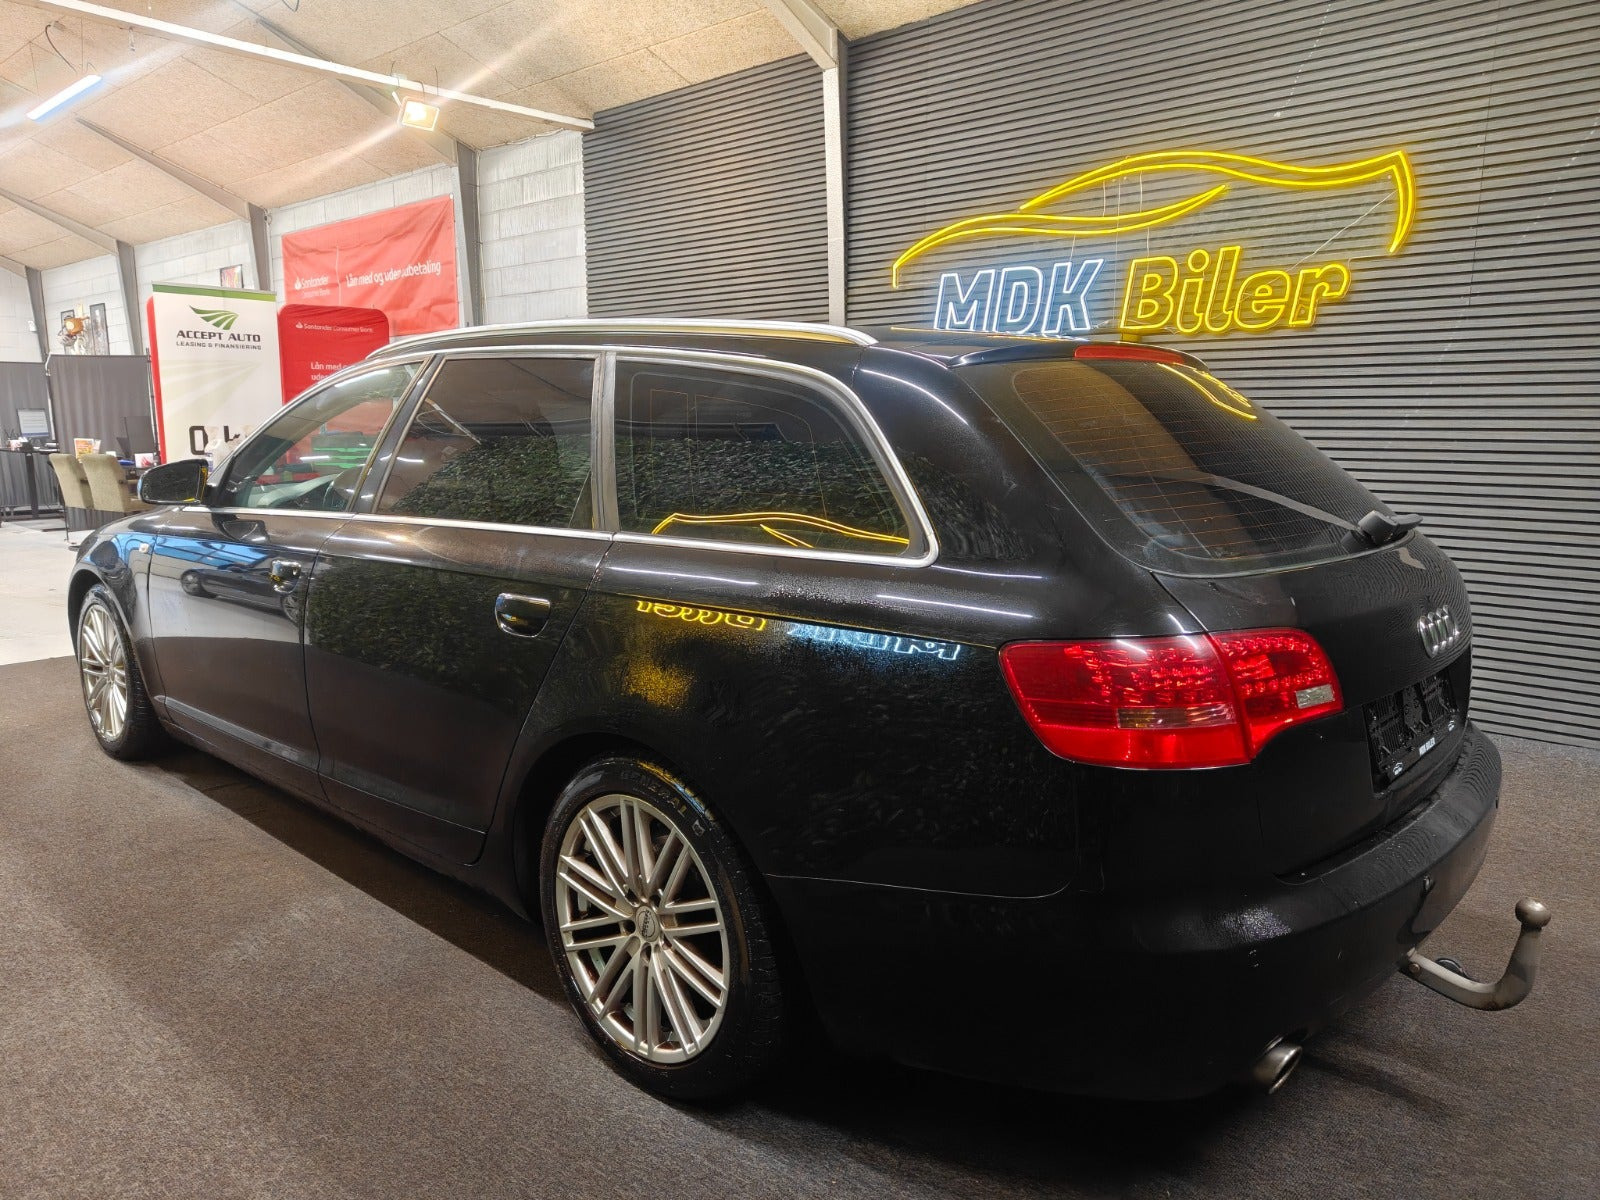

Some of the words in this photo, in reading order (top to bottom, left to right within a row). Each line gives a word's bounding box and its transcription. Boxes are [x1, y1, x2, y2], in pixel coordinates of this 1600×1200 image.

[402, 260, 441, 277] dbetaling
[933, 258, 1104, 334] MDK
[1120, 246, 1349, 333] Biler
[176, 330, 223, 340] ACCEPT
[228, 333, 261, 342] AUTO
[311, 361, 324, 370] Lån
